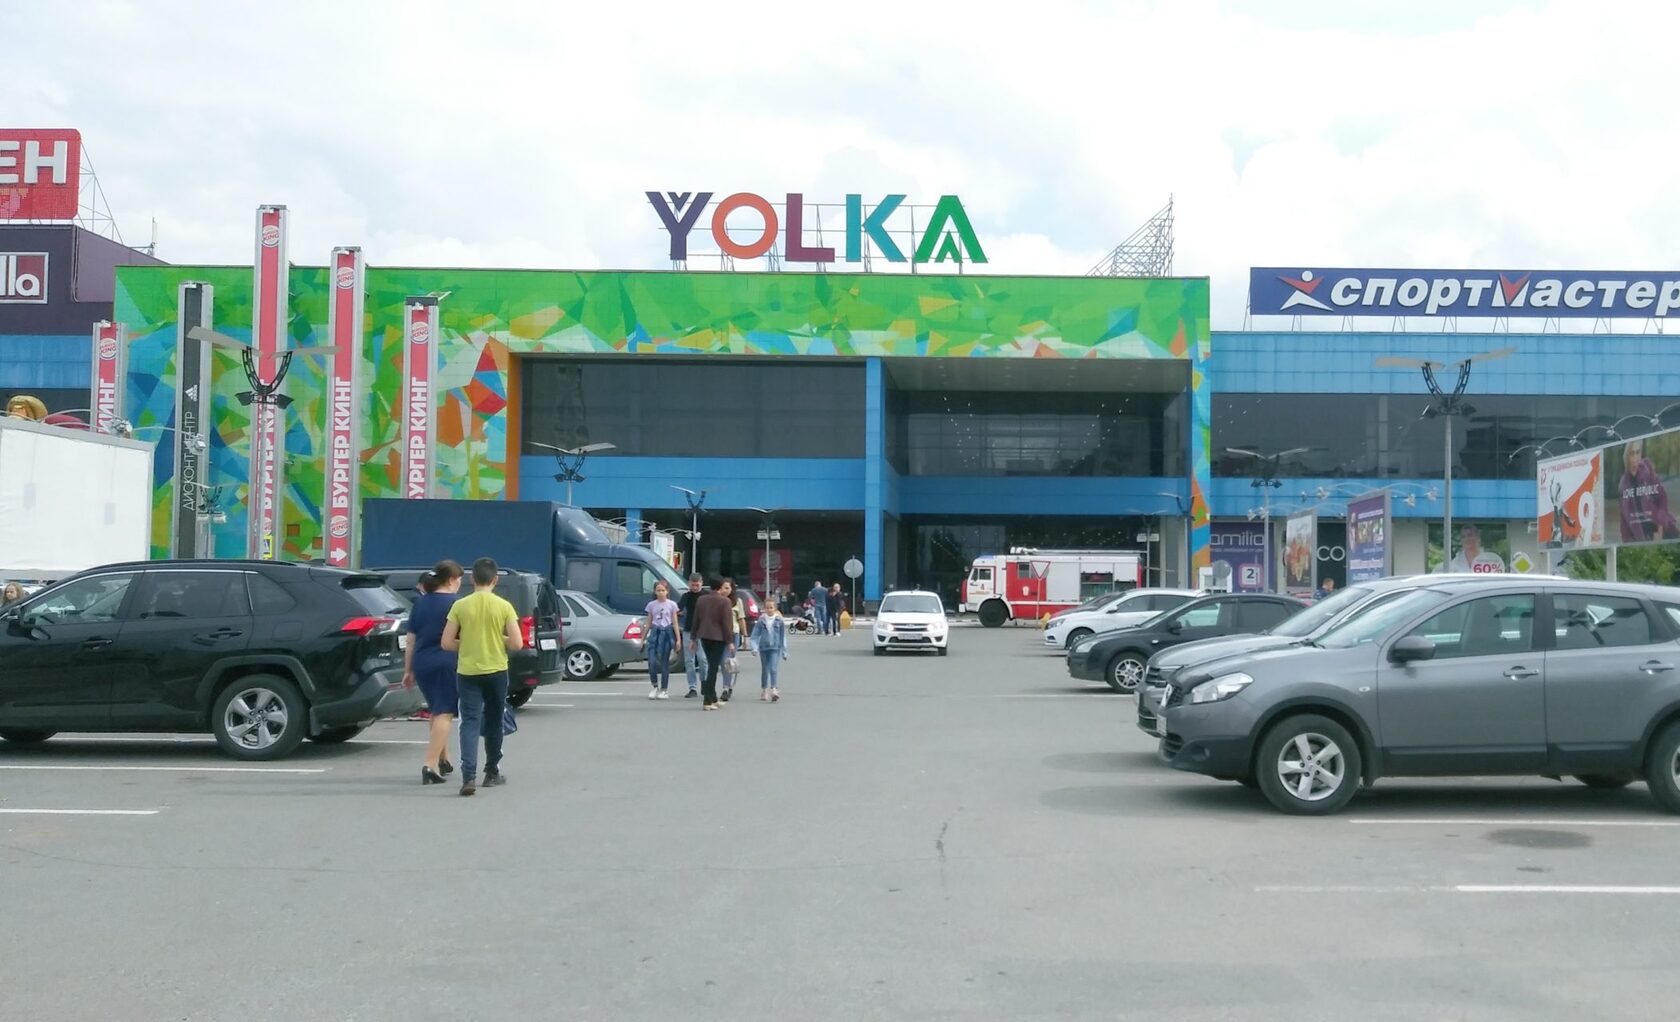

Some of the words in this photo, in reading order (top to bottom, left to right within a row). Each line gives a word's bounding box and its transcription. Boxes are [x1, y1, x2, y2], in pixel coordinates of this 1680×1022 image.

[645, 191, 989, 264] YOLKA
[335, 377, 350, 431] КИНГ
[411, 377, 427, 431] КИНГ
[183, 452, 195, 511] ДИСКОНТ
[333, 435, 349, 509] БУРГЕР
[409, 435, 426, 499] УРГЕР
[1246, 568, 1255, 579] 2
[1473, 563, 1503, 573] 60%
